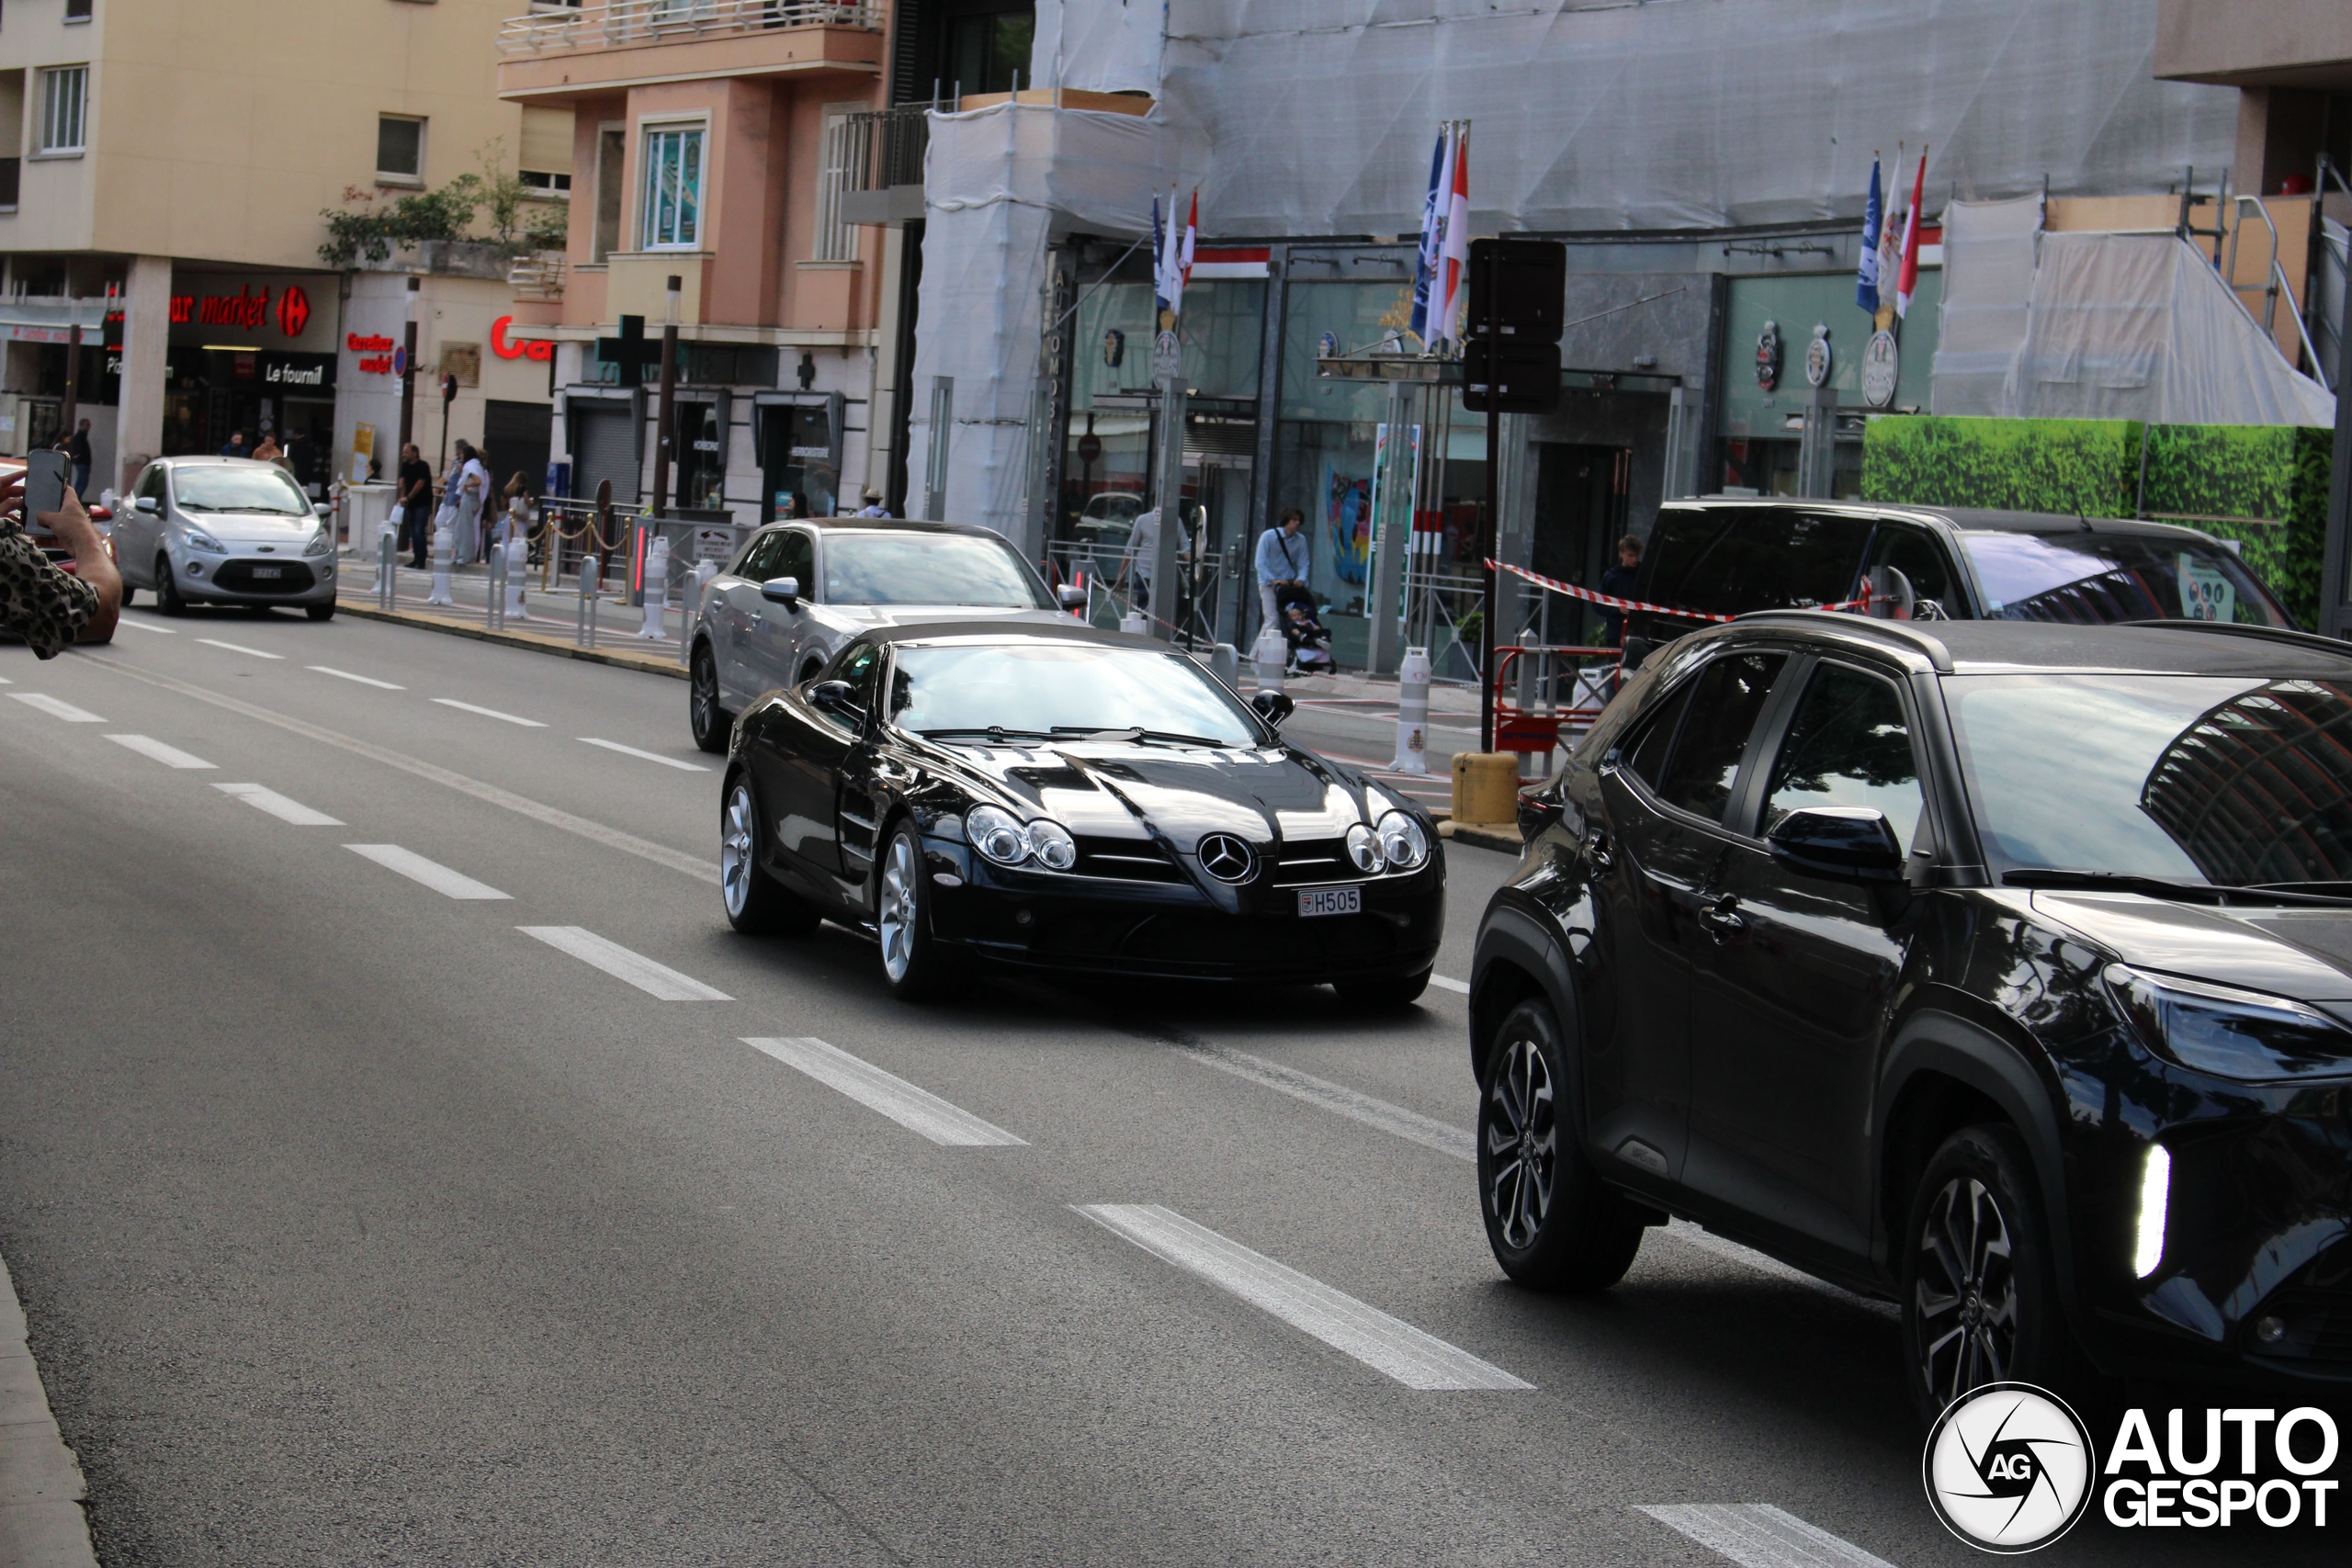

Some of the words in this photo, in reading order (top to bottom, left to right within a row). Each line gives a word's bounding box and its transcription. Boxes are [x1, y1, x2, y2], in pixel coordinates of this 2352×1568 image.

[199, 284, 268, 331] market
[266, 364, 279, 383] Le
[282, 363, 323, 385] fournil
[1315, 891, 1358, 913] H505
